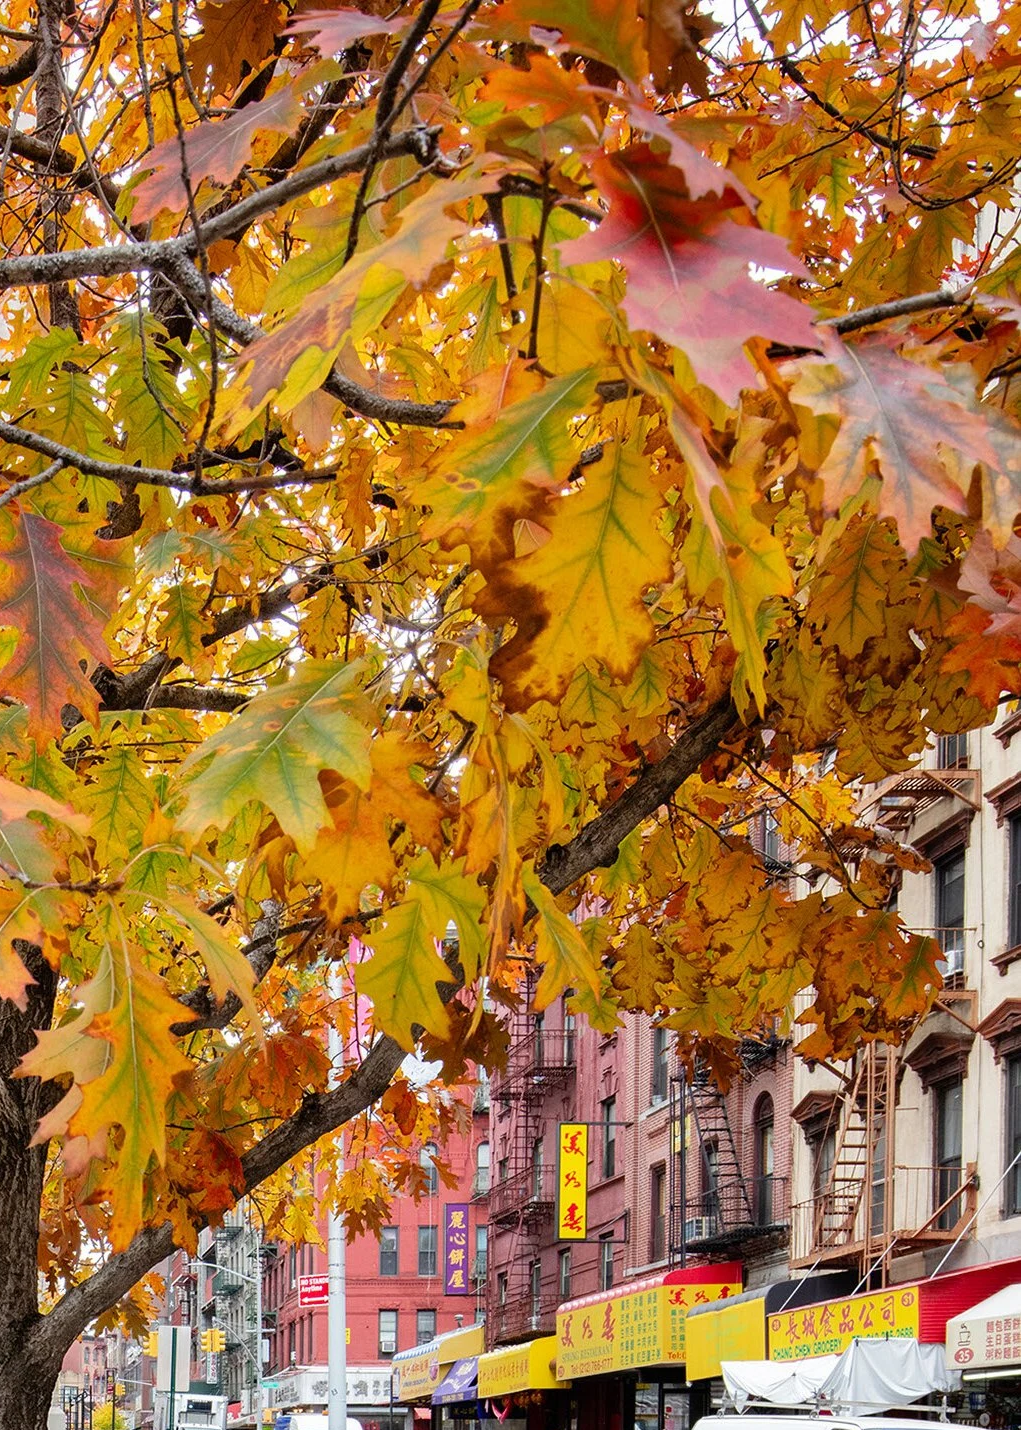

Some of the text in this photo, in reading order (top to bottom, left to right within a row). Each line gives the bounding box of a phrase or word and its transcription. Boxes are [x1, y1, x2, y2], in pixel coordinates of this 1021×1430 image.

[301, 1285, 323, 1293] Anytime
[785, 1295, 896, 1344] 長城食品公司
[580, 1343, 613, 1359] RESTAURANT
[773, 1346, 793, 1360] CHANG
[813, 1338, 843, 1354] GROCERY
[958, 1349, 970, 1362] 35
